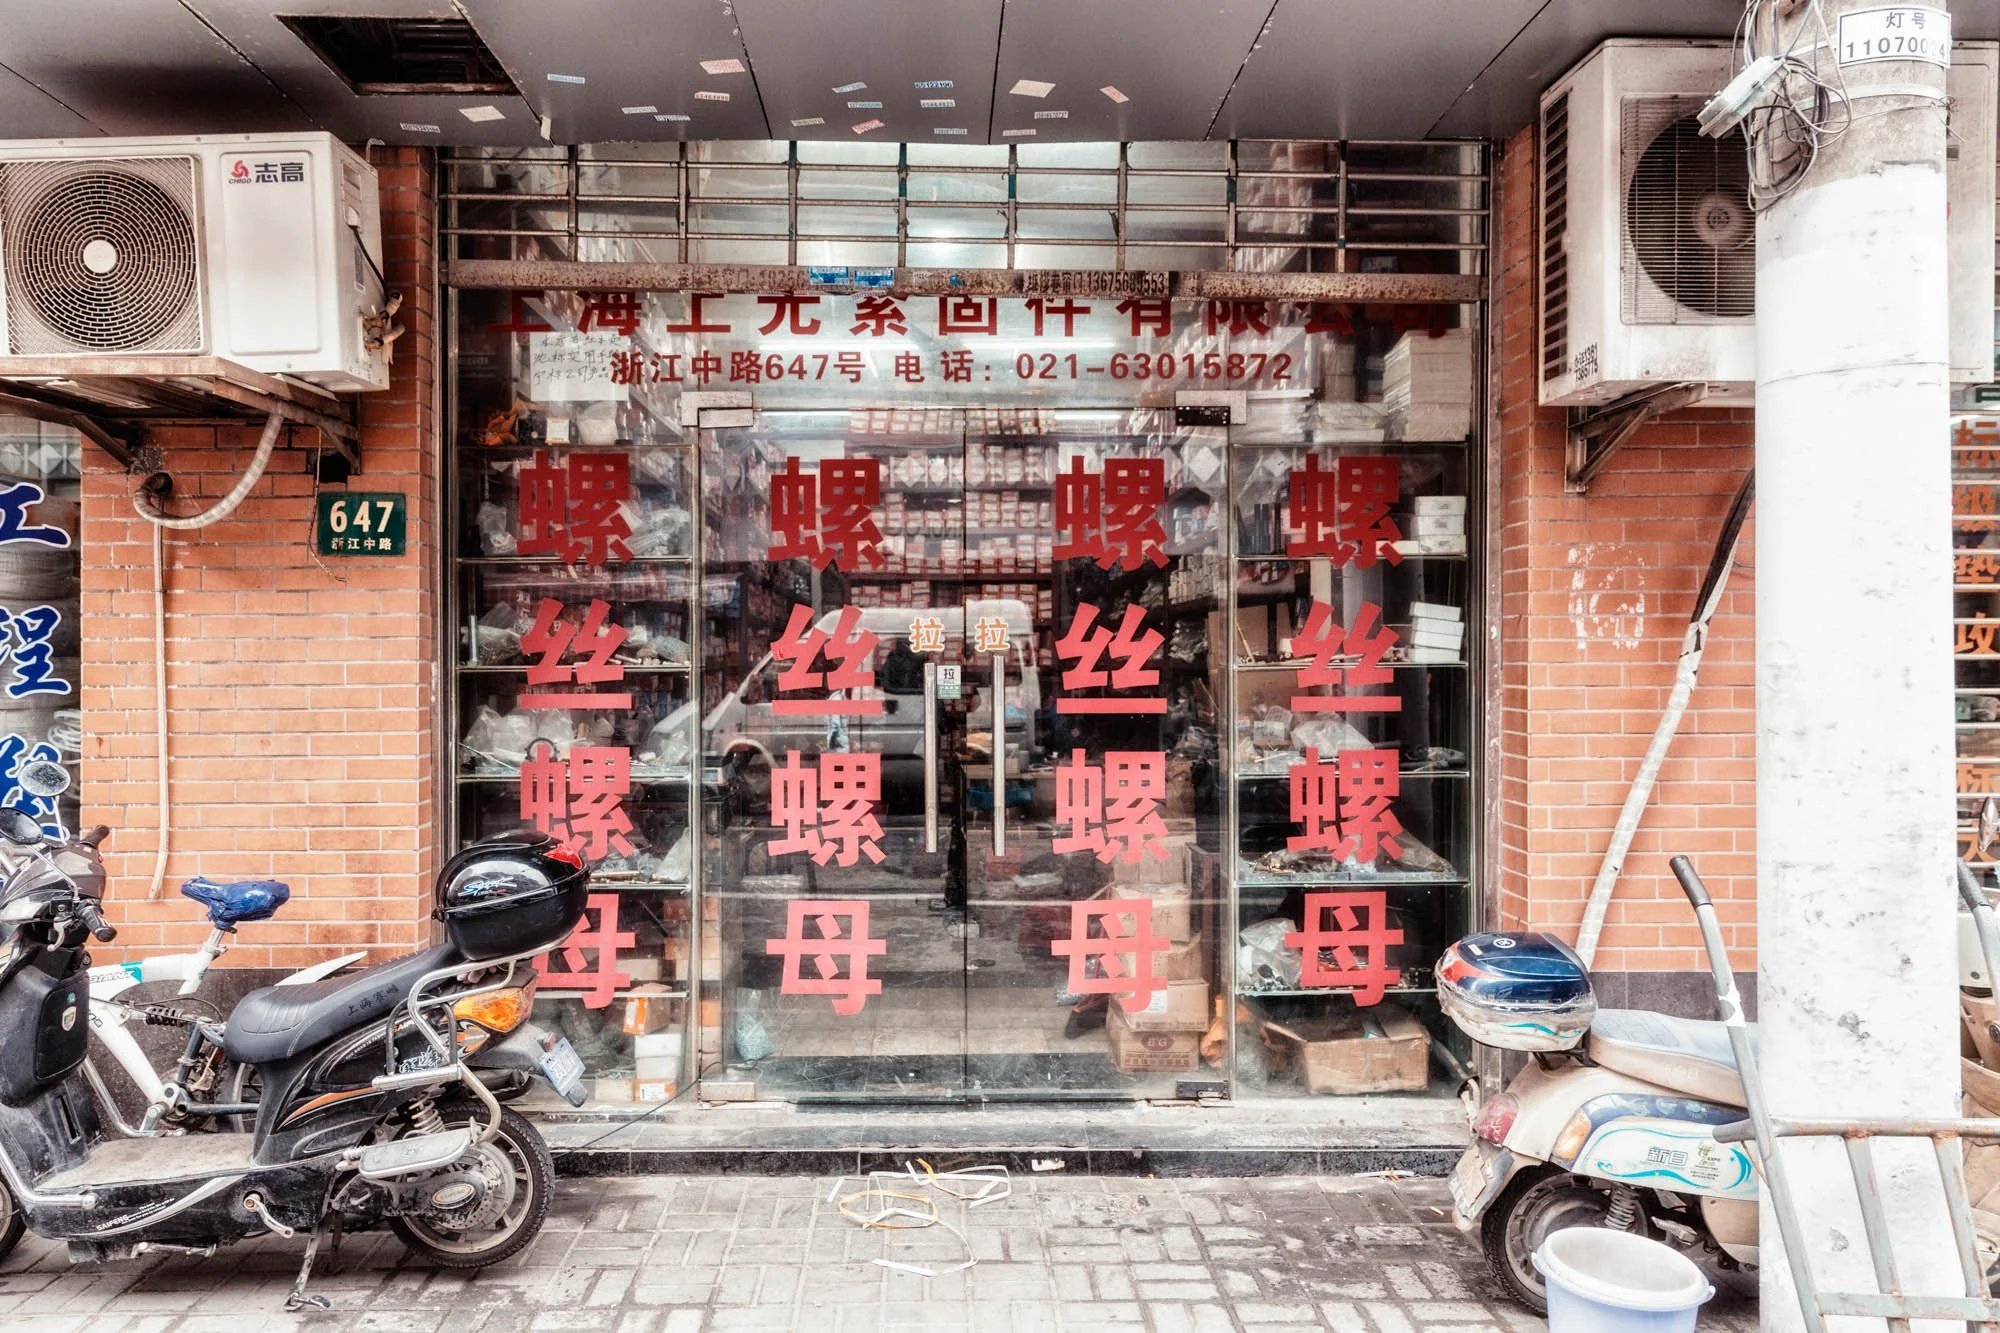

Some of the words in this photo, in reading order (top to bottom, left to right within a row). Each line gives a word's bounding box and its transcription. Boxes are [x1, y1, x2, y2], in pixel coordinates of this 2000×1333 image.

[1885, 12, 1926, 29] 灯号
[1847, 37, 1945, 59] 1107004
[254, 162, 304, 184] 志高
[611, 350, 865, 385] 浙江中路647号
[1016, 352, 1292, 381] 021-63015872
[330, 500, 394, 533] 647
[331, 537, 392, 550] 浙江中路
[909, 617, 945, 652] 拉
[975, 617, 1010, 652] 拉
[516, 450, 636, 1009] 螺丝螺母
[766, 456, 887, 1016] 螺丝螺母
[1051, 455, 1171, 1013] 螺丝螺母
[1284, 454, 1405, 1007] 螺丝螺母
[1647, 1146, 1688, 1166] 新日
